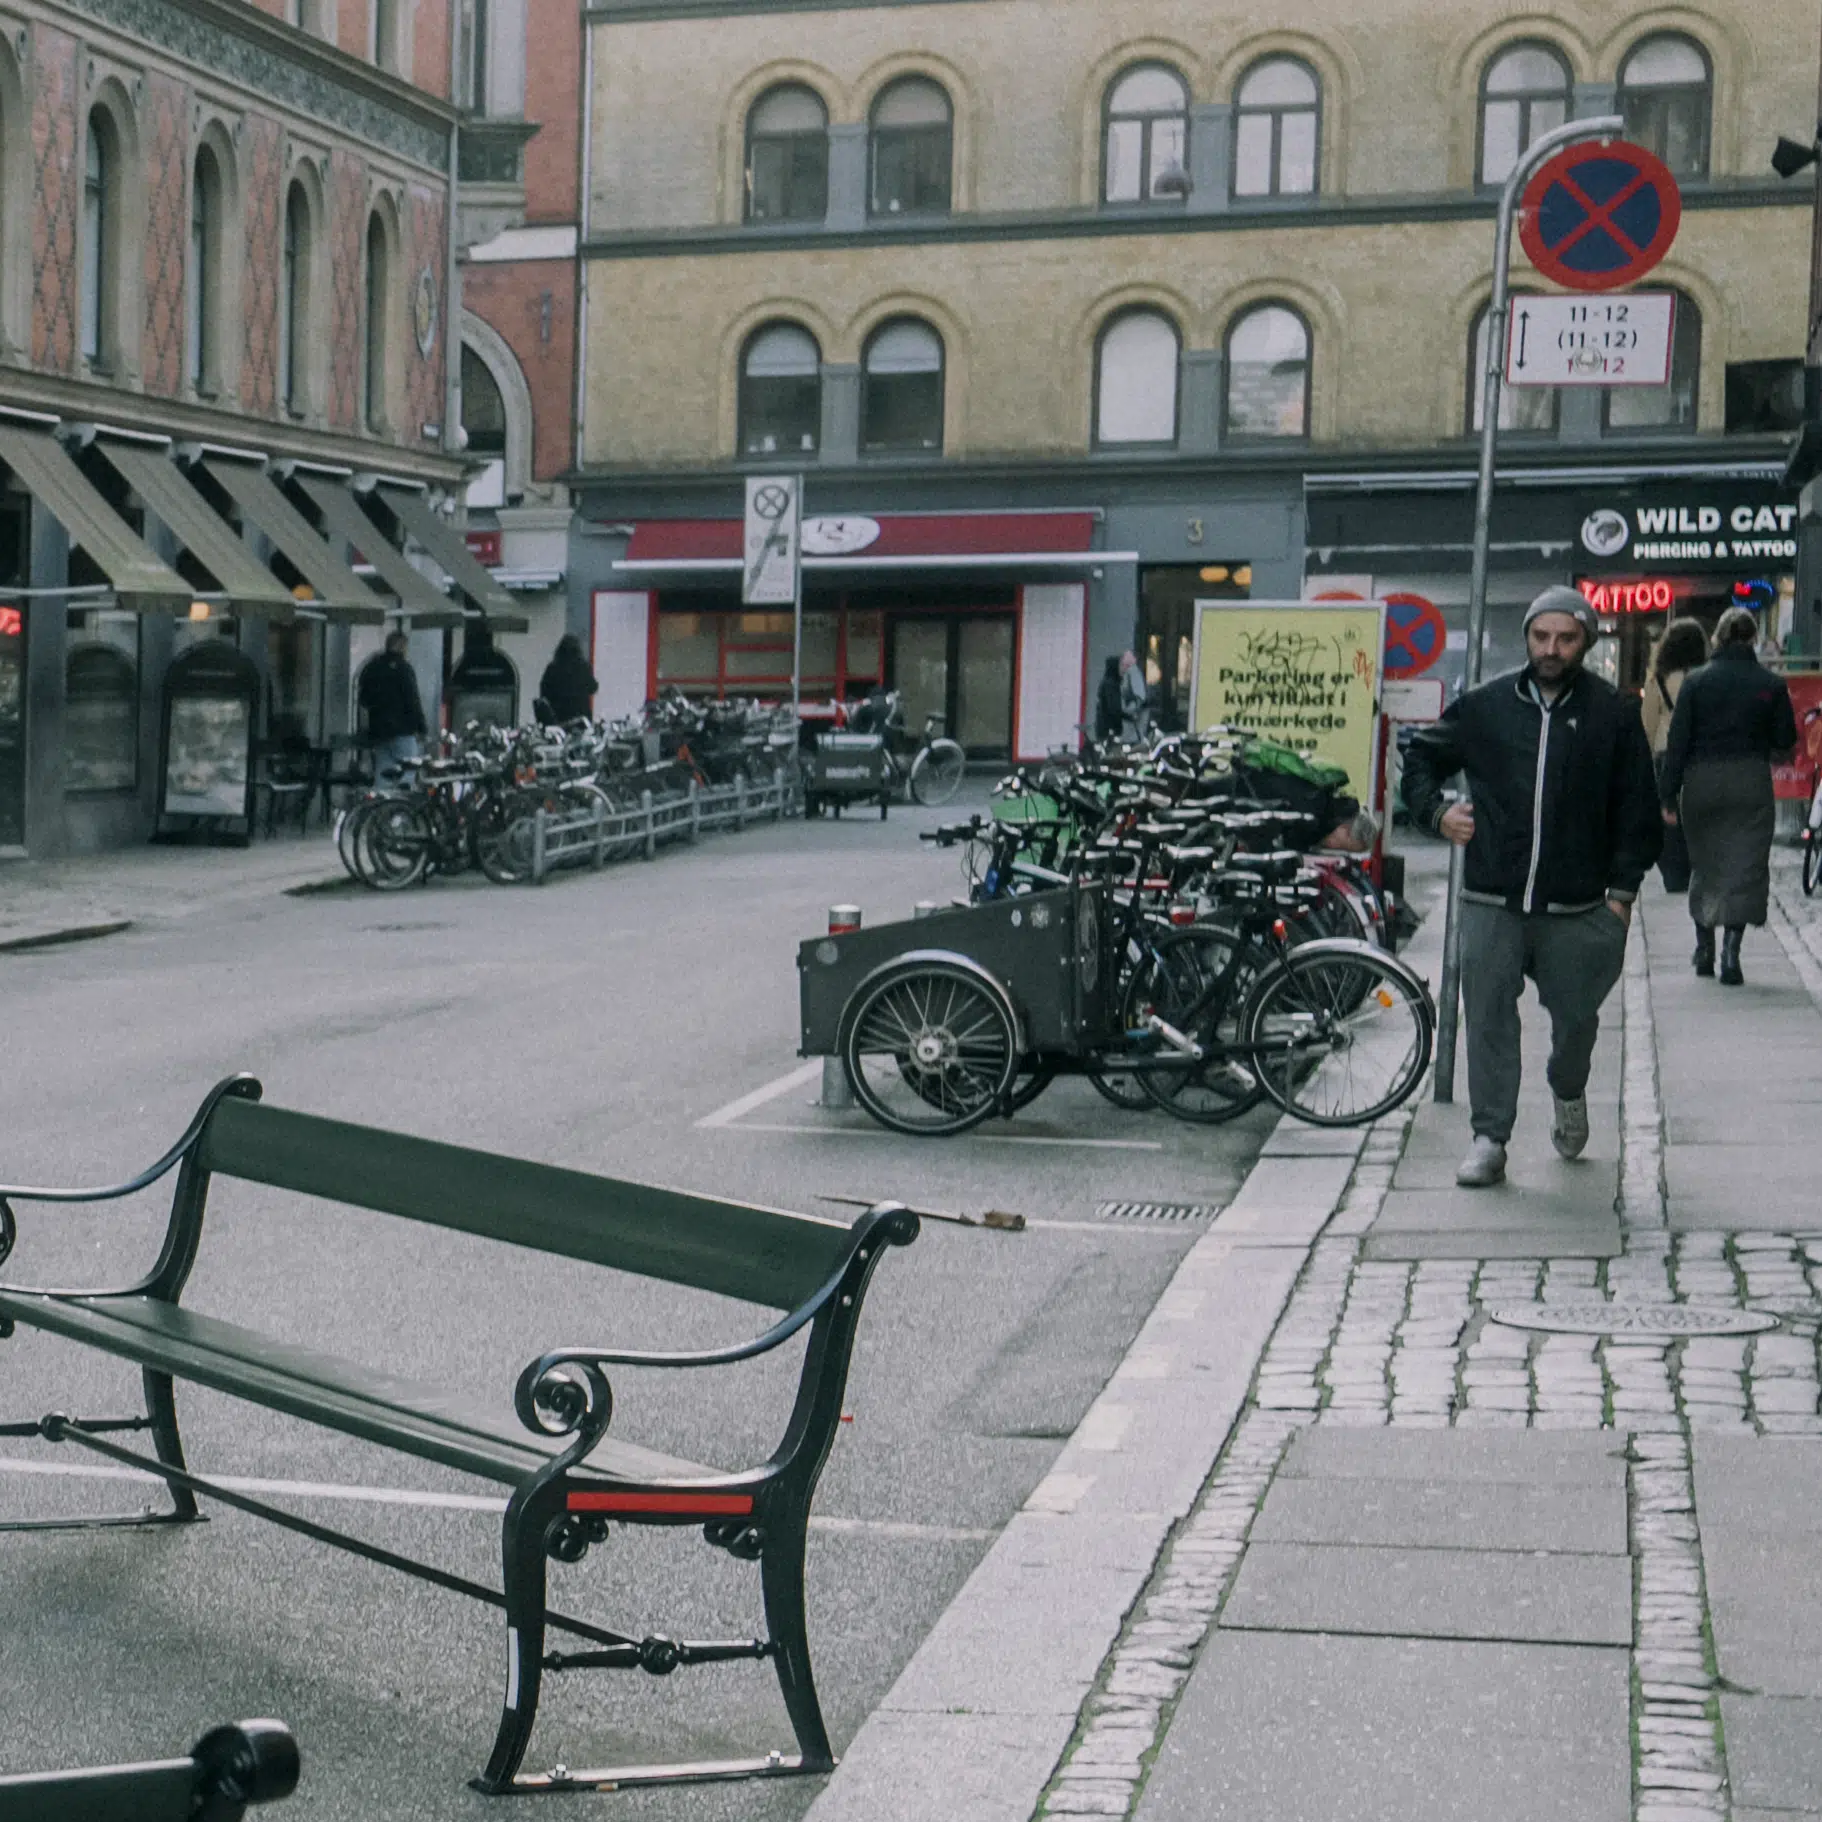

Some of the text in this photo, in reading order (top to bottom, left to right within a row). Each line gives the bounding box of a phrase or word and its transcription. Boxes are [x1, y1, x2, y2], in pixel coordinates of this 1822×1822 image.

[1187, 518, 1204, 543] 3
[1636, 504, 1798, 534] WILD CAT
[1633, 539, 1797, 560] PIERCING & TATTOO
[1580, 580, 1674, 612] TATTOO
[1219, 667, 1354, 690] Parkering er
[1220, 712, 1346, 728] afmærkede
